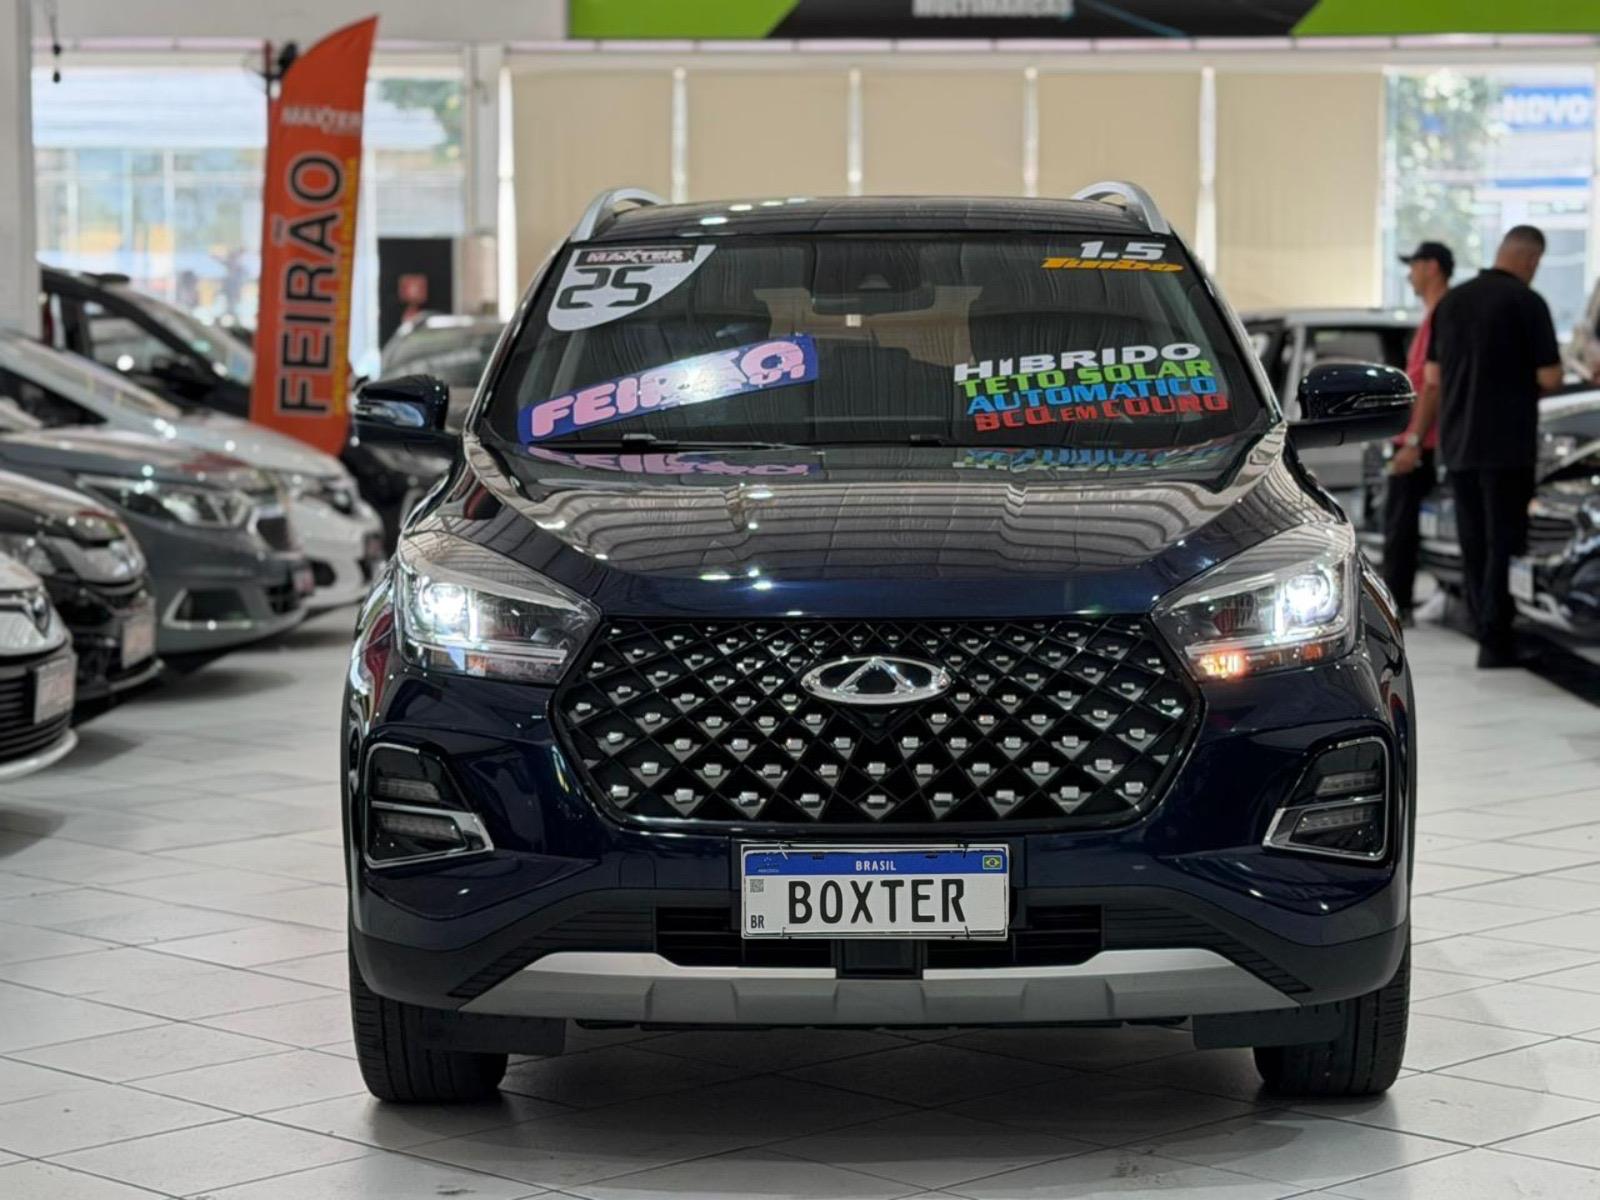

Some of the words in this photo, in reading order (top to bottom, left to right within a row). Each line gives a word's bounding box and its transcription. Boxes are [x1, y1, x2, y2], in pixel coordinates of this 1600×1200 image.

[586, 250, 683, 264] MAXTER
[1080, 241, 1166, 260] 1.5
[272, 152, 343, 415] FEIRÃO
[556, 266, 654, 310] 25
[957, 370, 1065, 397] TETO
[1078, 360, 1214, 384] SOLAR
[967, 376, 1217, 415] AUTOMATICO
[1060, 404, 1098, 422] EM
[1102, 393, 1229, 418] COURO
[855, 860, 896, 871] BRASIL
[788, 878, 966, 924] BOXTER
[750, 914, 765, 929] BR
